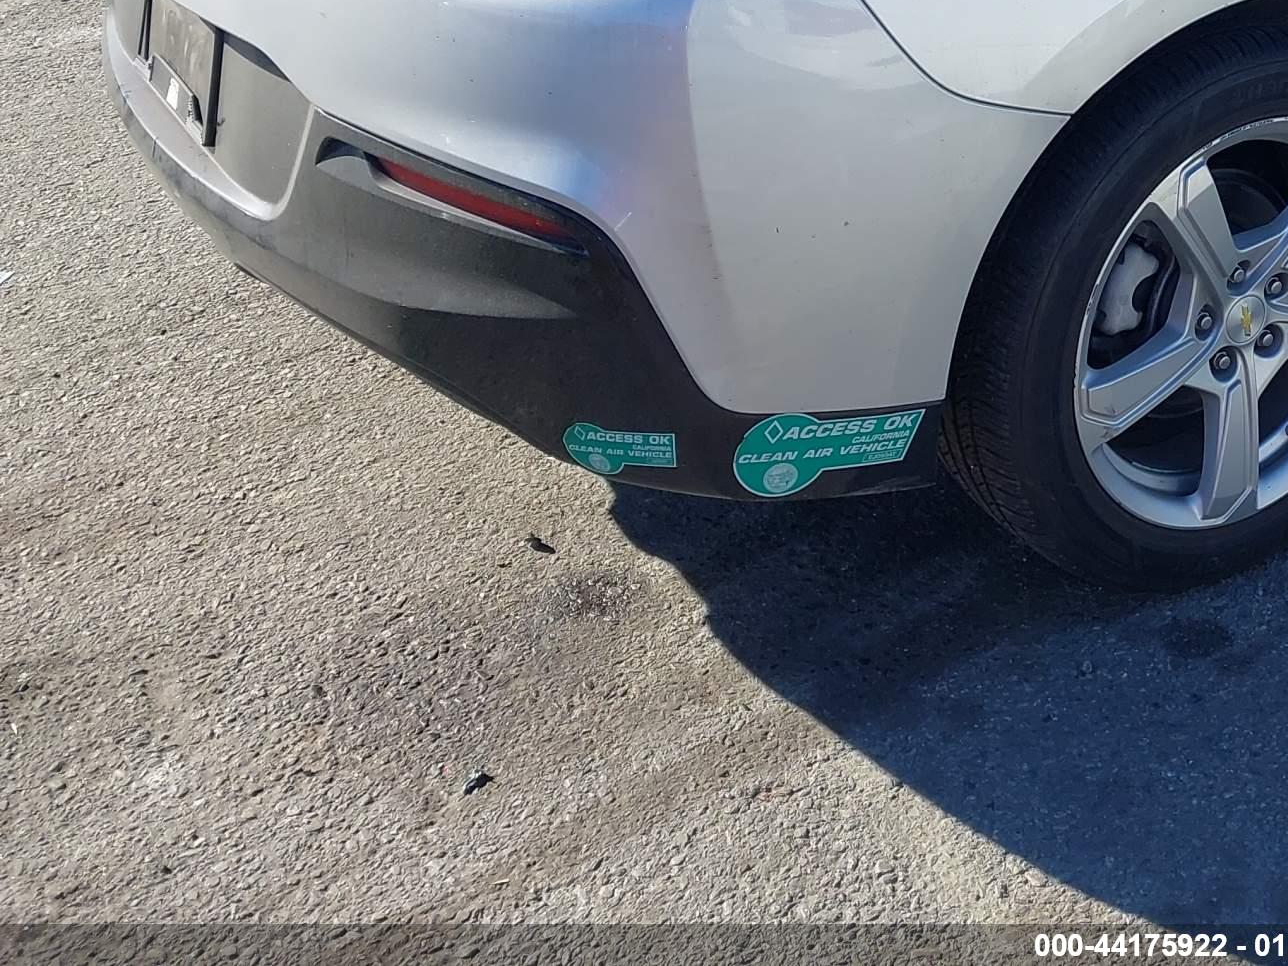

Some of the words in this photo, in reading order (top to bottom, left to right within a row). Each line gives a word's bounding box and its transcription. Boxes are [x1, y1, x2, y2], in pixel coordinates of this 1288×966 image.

[783, 419, 877, 440] ACCESS
[884, 414, 917, 430] OK
[586, 432, 643, 444] ACCESS
[649, 435, 670, 445] OK
[852, 430, 910, 444] CALIFORNIA
[568, 444, 602, 453] CLEAN
[627, 450, 672, 458] VEHICLE
[738, 451, 798, 463] CLEAN
[803, 448, 833, 459] AIR
[840, 438, 907, 455] VEHICLE
